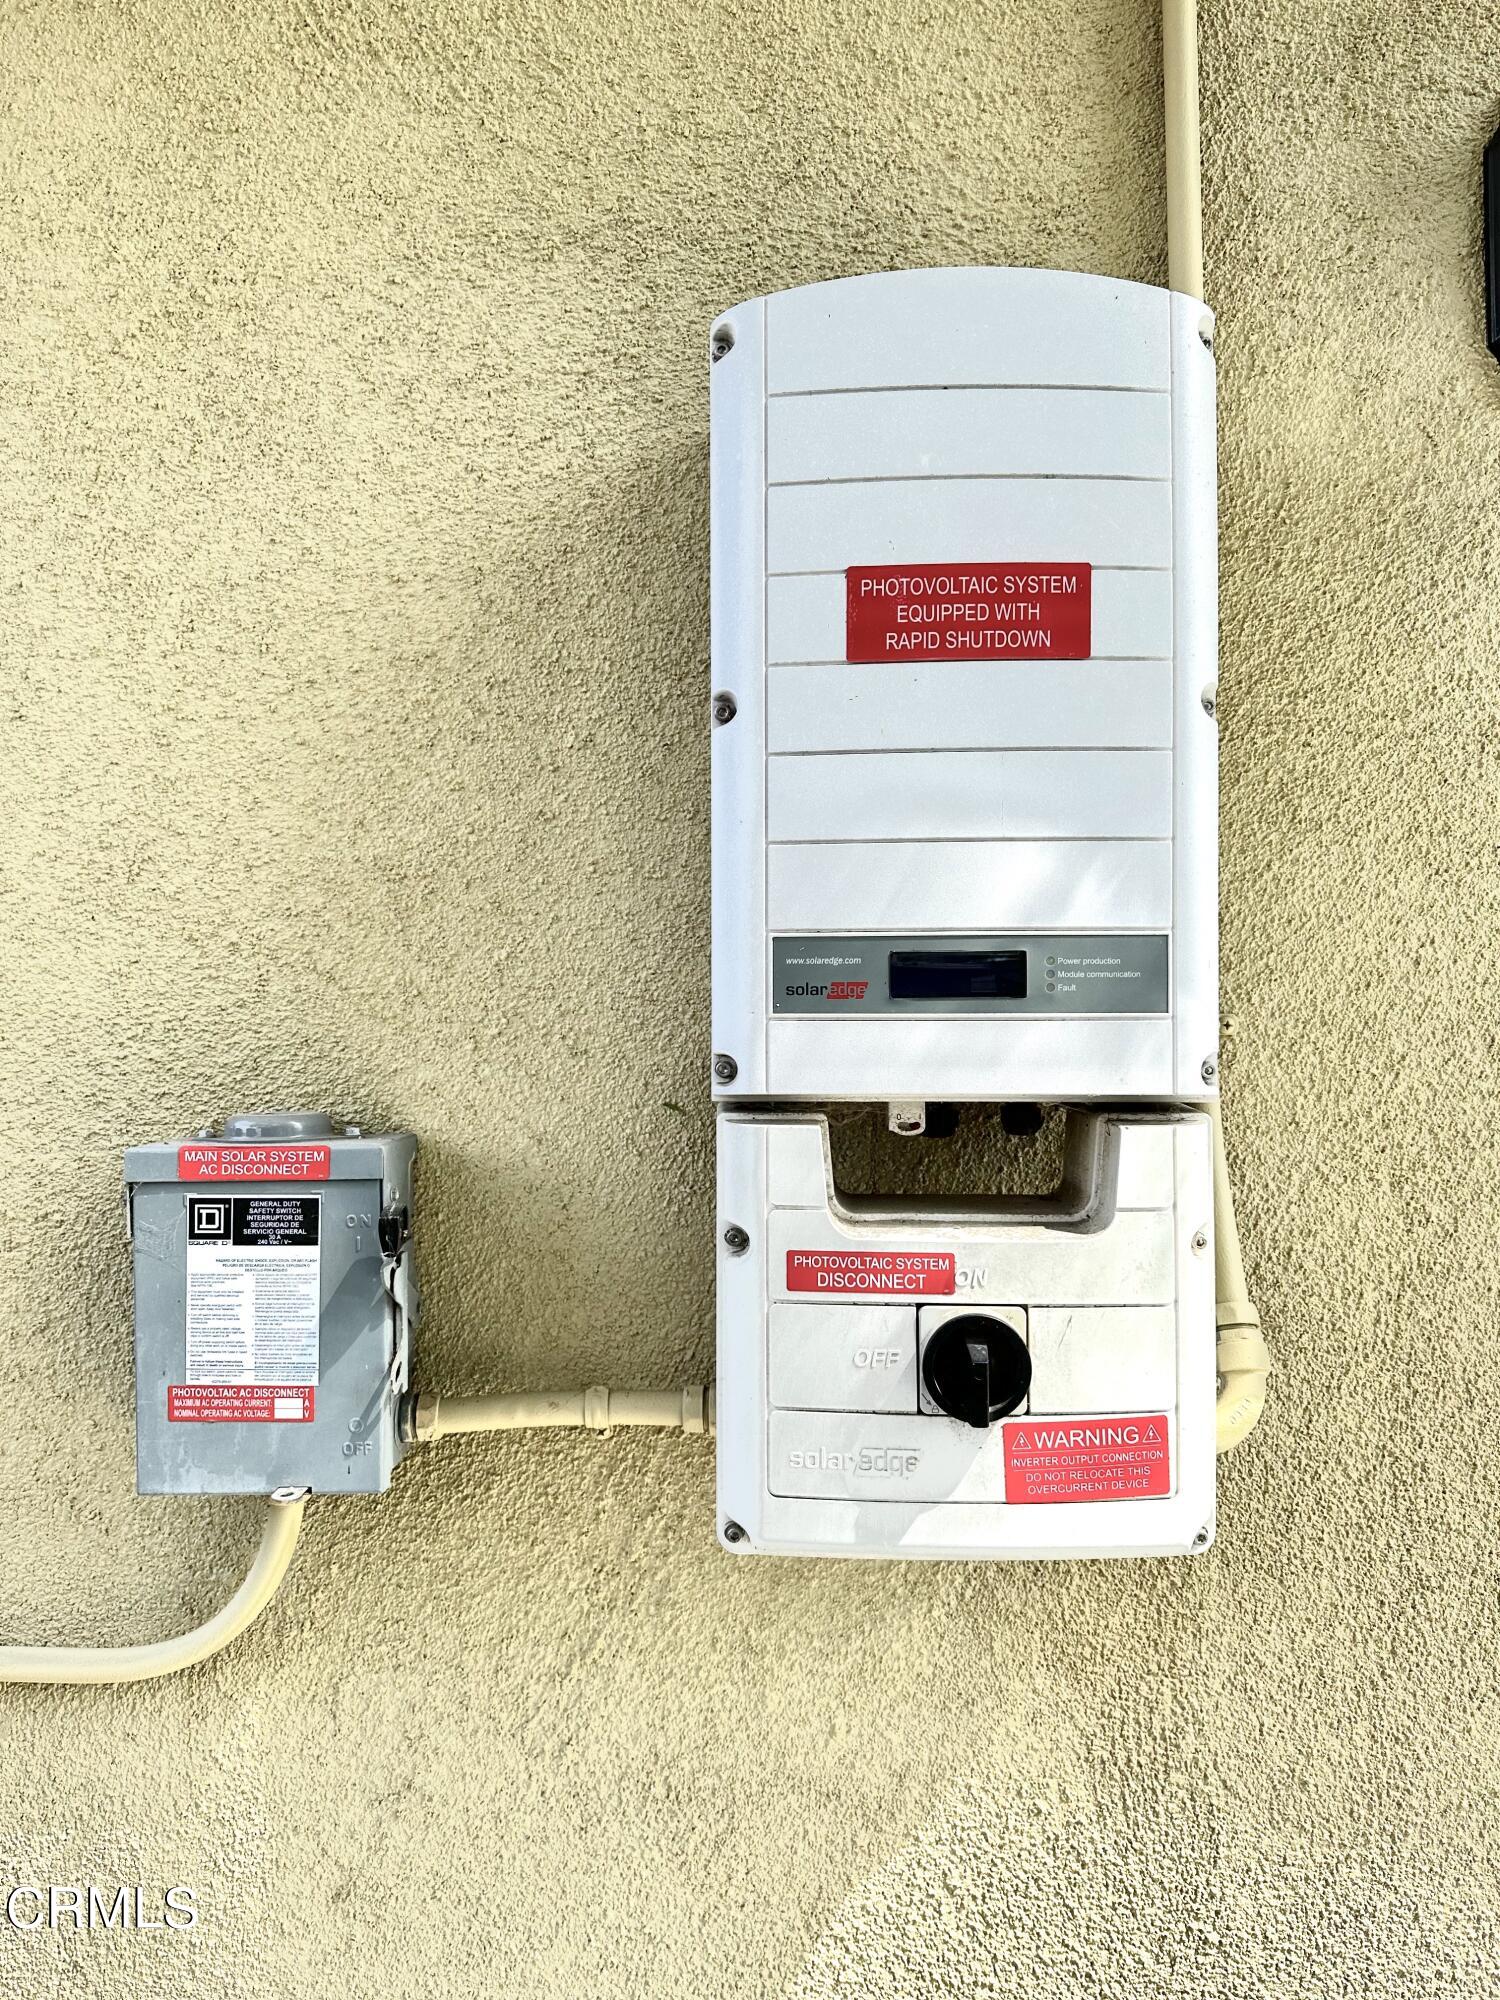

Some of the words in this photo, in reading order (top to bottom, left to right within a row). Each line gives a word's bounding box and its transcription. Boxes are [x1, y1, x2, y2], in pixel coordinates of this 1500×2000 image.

[861, 576, 998, 597] PHOTOVOLTAIC
[1003, 576, 1077, 594] SYSTEM
[897, 604, 989, 623] EQUIPPED
[995, 603, 1040, 621] WITH
[886, 631, 940, 650] RAPID
[945, 630, 1051, 649] SHUTDOWN
[785, 956, 862, 966] www.solaredge.com
[1057, 957, 1081, 965] Power
[1082, 957, 1121, 966] production
[1057, 970, 1085, 978] Module
[1086, 970, 1141, 978] communication
[1057, 984, 1077, 992] Fault
[184, 1151, 218, 1162] MAIN
[221, 1151, 265, 1162] SOLAR
[270, 1150, 325, 1162] SYSTEM
[199, 1164, 218, 1175] AC
[221, 1164, 310, 1175] DISCONNECT
[346, 1214, 372, 1228] ON
[794, 1256, 893, 1270] PHOTOVOLTAIC
[896, 1257, 950, 1271] SYSTEM
[817, 1272, 926, 1289] DISCONNECT
[955, 1267, 988, 1289] ON
[853, 1351, 900, 1370] OFF
[172, 1388, 237, 1397] PHOTOVOLTAIC
[240, 1388, 252, 1397] AC
[254, 1388, 310, 1398] DISCONNECT
[173, 1399, 200, 1407] MAXIMUM
[201, 1399, 210, 1407] AC
[211, 1399, 243, 1407] OPERATING
[244, 1399, 272, 1407] CURRENT:
[173, 1409, 200, 1418] NOMINAL
[200, 1409, 233, 1418] OPERATING
[233, 1409, 242, 1418] AC
[242, 1409, 271, 1418] VOLTAGE:
[304, 1410, 310, 1418] V
[1033, 1426, 1139, 1449] WARNING
[342, 1441, 373, 1457] OFF
[1011, 1457, 1058, 1467] INVERTER
[1061, 1454, 1100, 1465] OUTPUT
[1102, 1450, 1164, 1463] CONNECTION
[1026, 1473, 1042, 1482] DO
[1045, 1472, 1066, 1481] NOT
[1069, 1468, 1127, 1480] RELOCATE
[1128, 1466, 1151, 1476] THIS
[1028, 1481, 1109, 1495] OVERCURRENT
[1112, 1479, 1149, 1490] DEVICE
